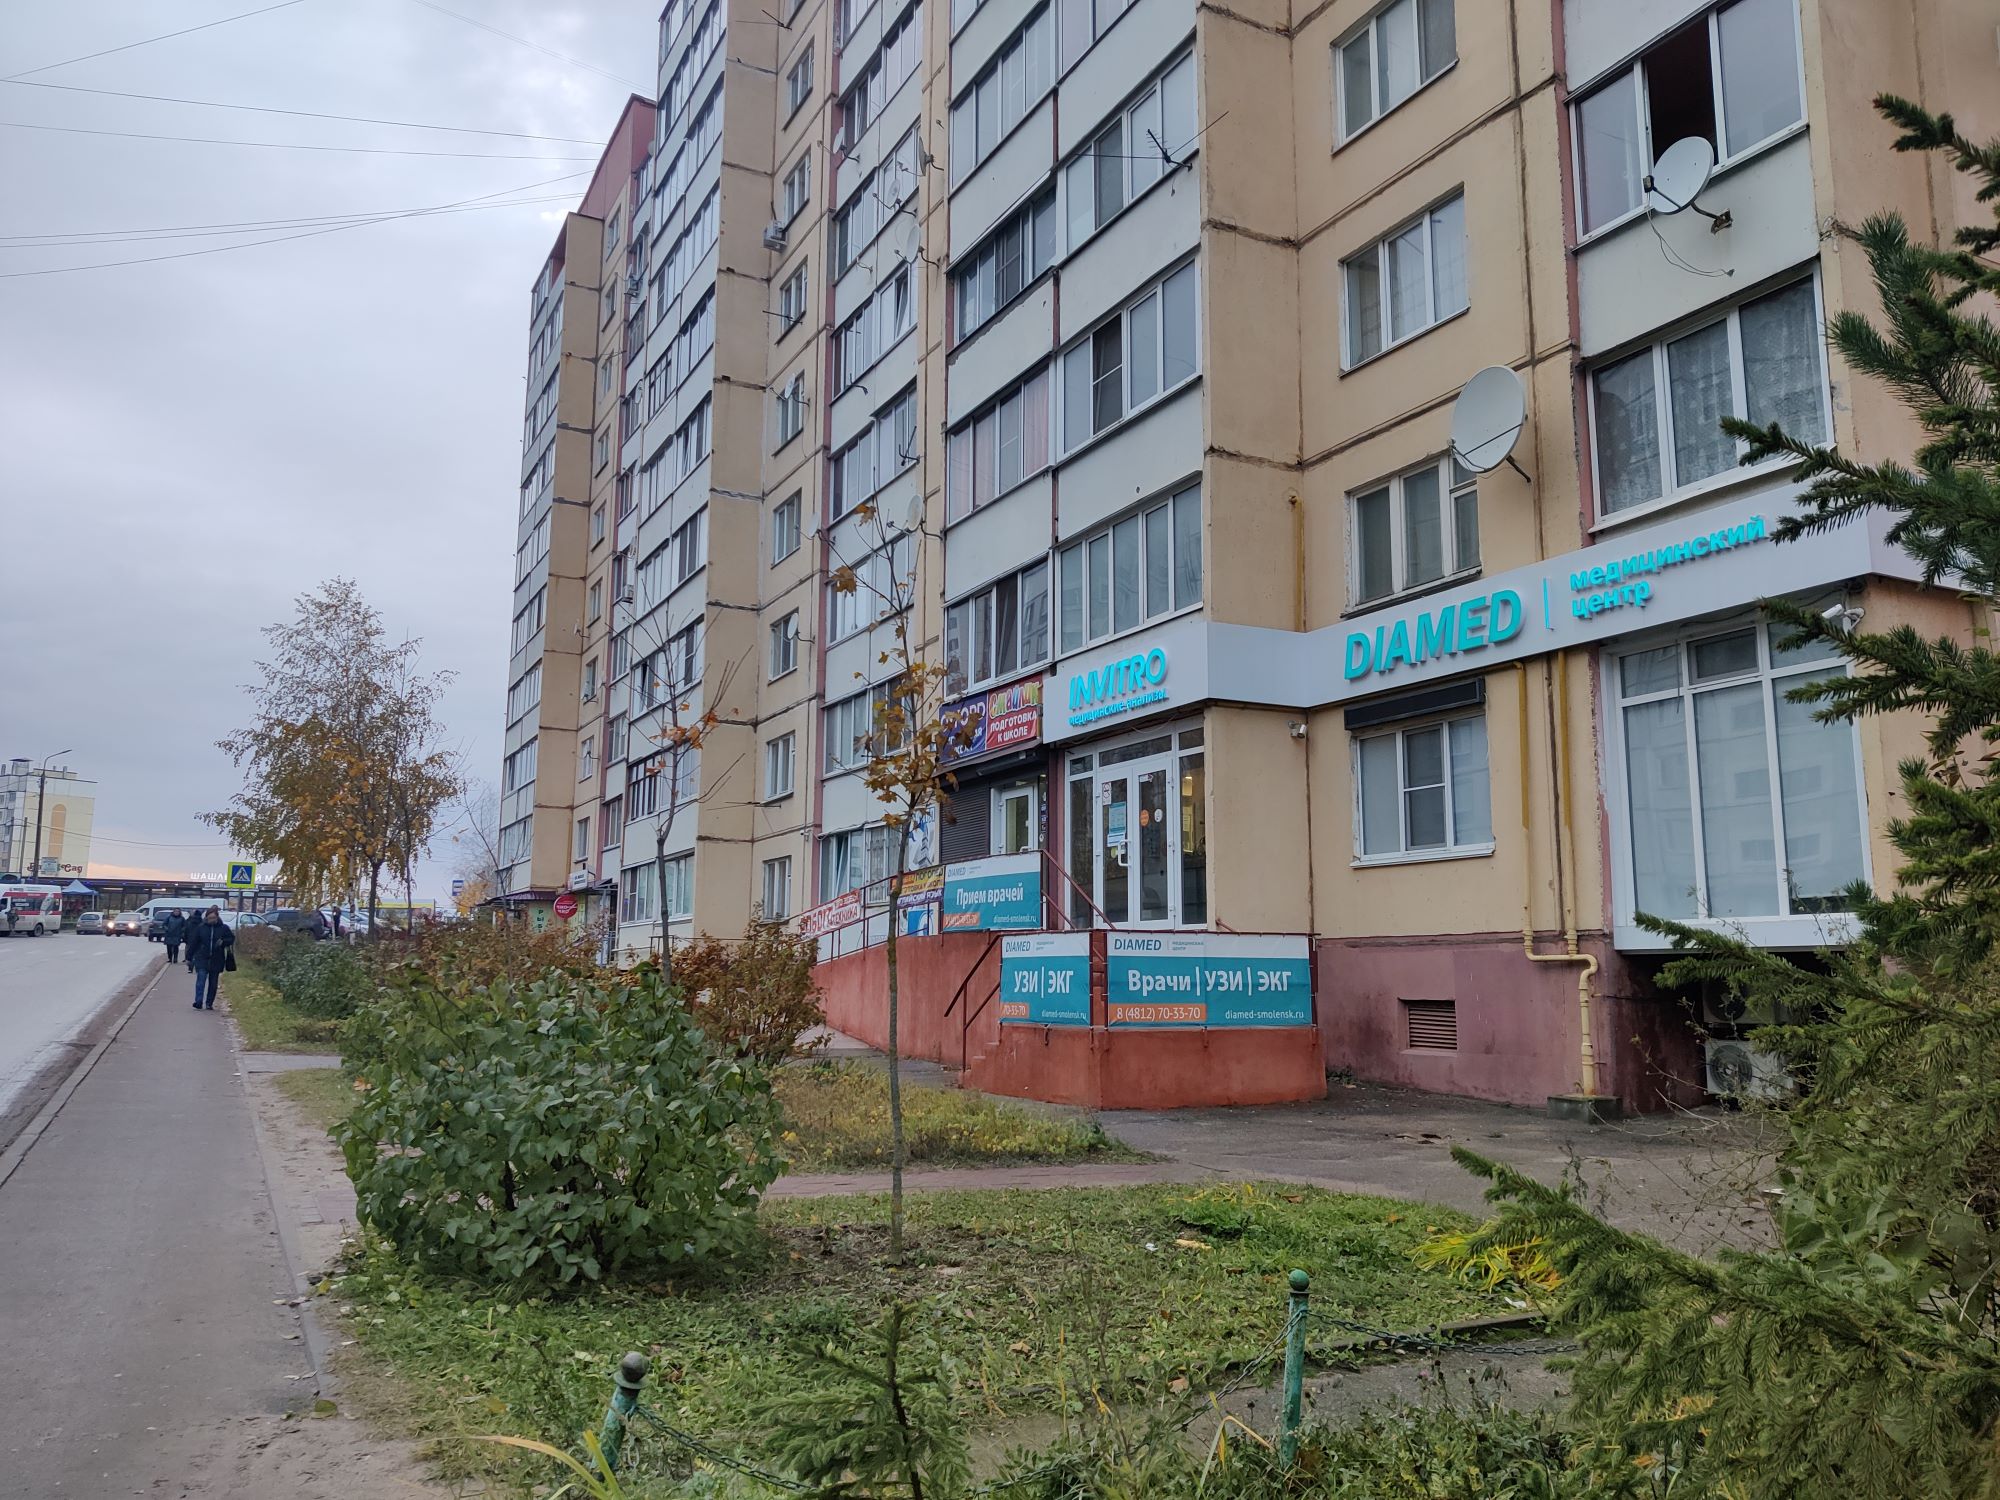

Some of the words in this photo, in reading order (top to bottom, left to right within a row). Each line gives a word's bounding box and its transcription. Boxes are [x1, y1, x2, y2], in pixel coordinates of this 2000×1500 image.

[1570, 516, 1765, 592] медицинский
[1572, 580, 1652, 618] центр
[1344, 588, 1523, 680] DIAMED
[1069, 648, 1166, 711] INVITRO
[1068, 702, 1125, 726] медицинские
[1126, 688, 1168, 711] анализы
[991, 710, 1037, 732] ПОДГОТОВКА
[997, 733, 1003, 743] К
[1003, 726, 1028, 741] ШКОЛЕ
[956, 887, 986, 909] Прием
[988, 882, 1024, 907] врачей
[993, 914, 1037, 924] diamed-smolensk.ru
[1005, 941, 1031, 952] DIAMED
[1114, 939, 1162, 951] DIAMED
[1014, 970, 1038, 993] УЗИ
[1047, 970, 1074, 993] ЭКГ
[1128, 969, 1191, 996] Врачи
[1204, 970, 1243, 991] УЗИ
[1257, 971, 1292, 991] ЭКГ
[1041, 1009, 1087, 1019] diamed-smolensk.ru
[1116, 1007, 1123, 1019] 8
[1125, 1007, 1156, 1021] (4812)
[1158, 1007, 1201, 1019] 70-33-70
[1225, 1008, 1304, 1020] diamed-smolensk.ru
